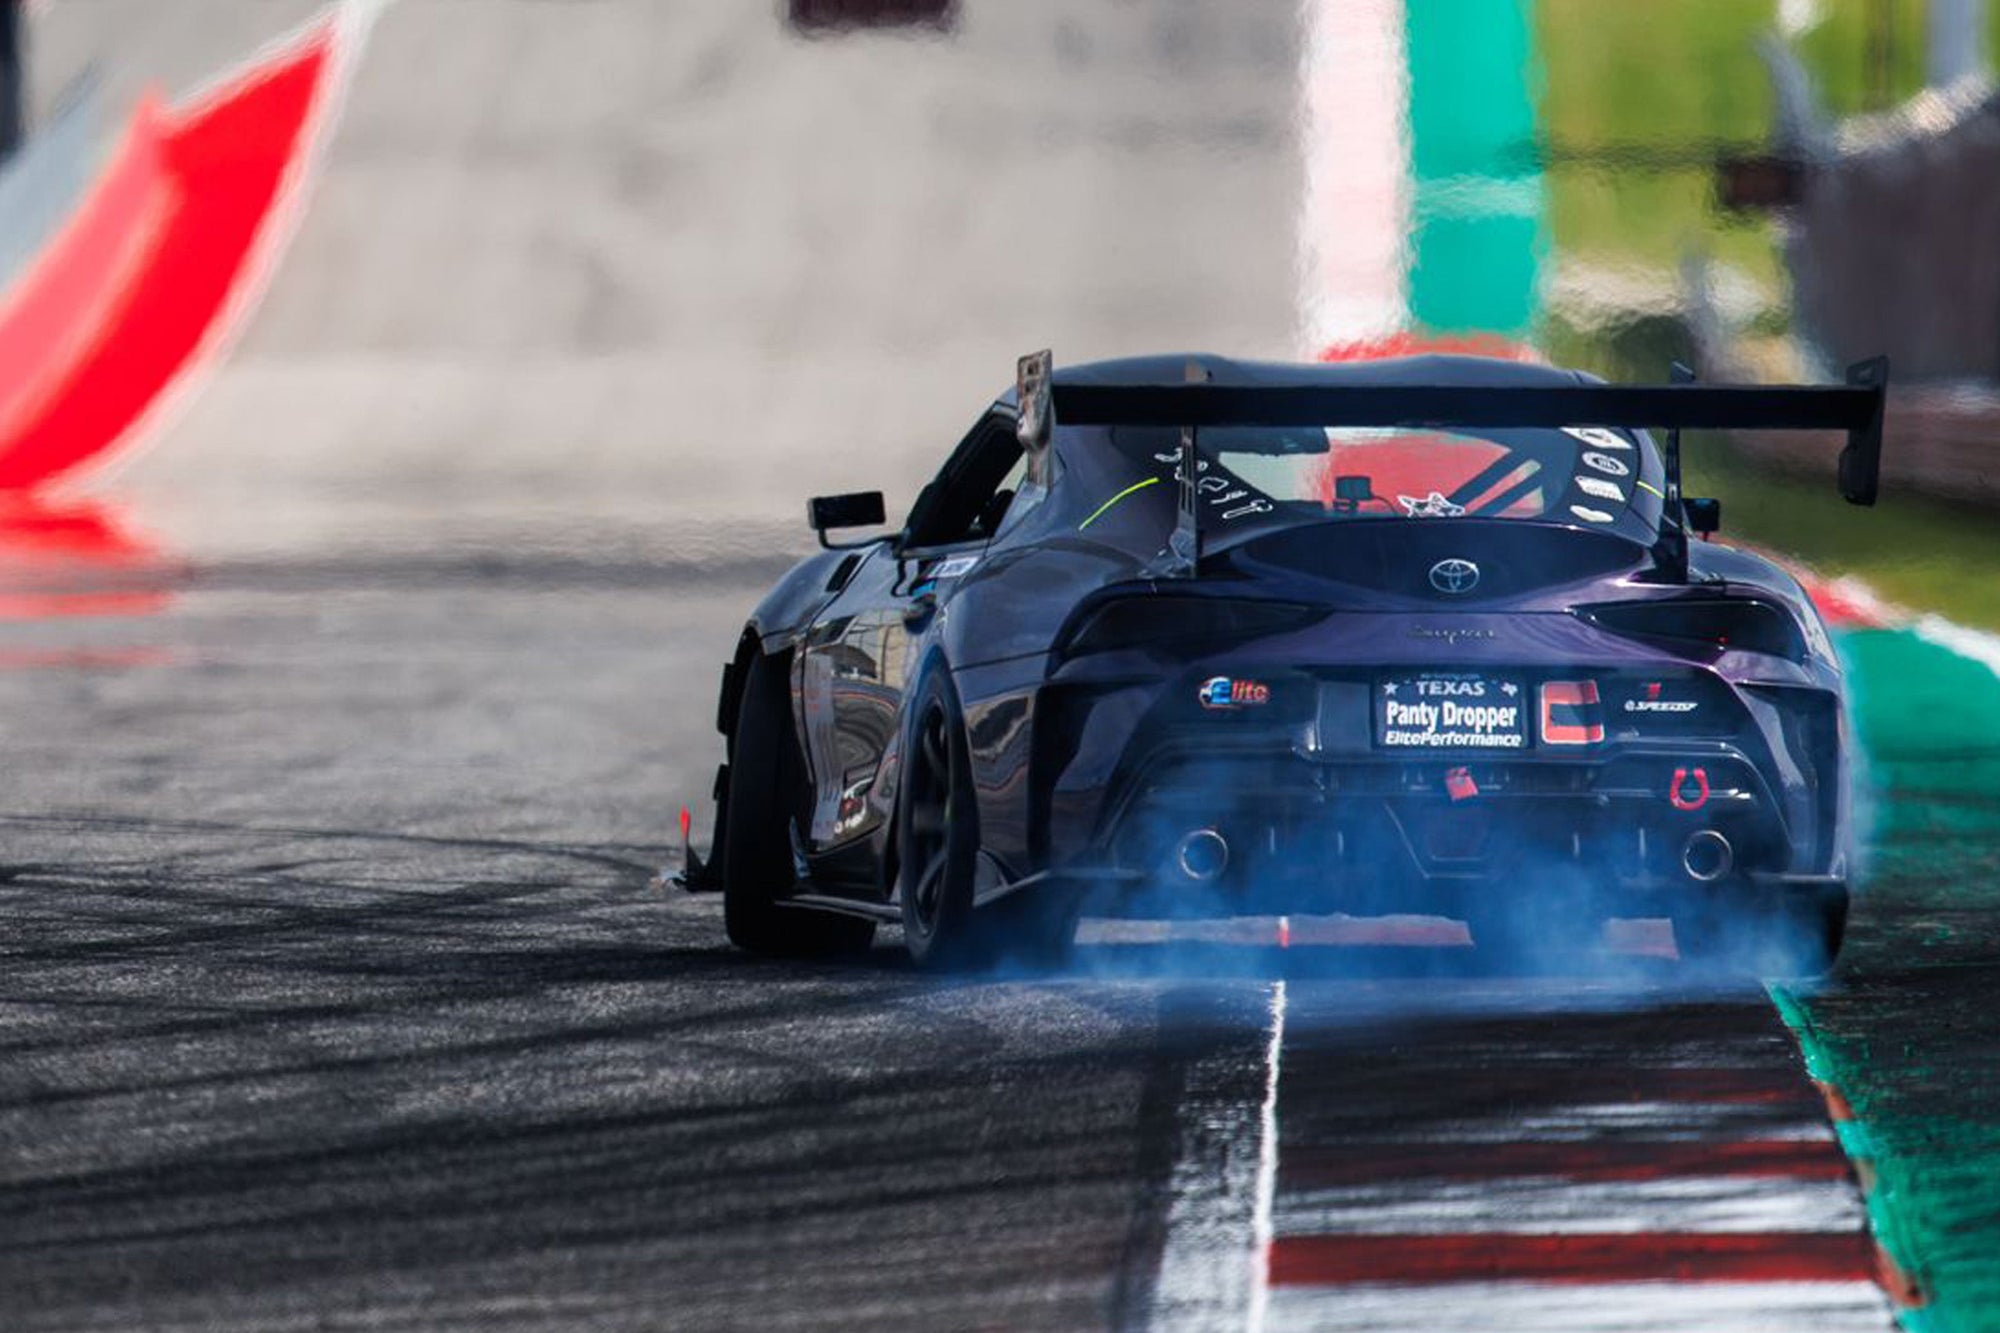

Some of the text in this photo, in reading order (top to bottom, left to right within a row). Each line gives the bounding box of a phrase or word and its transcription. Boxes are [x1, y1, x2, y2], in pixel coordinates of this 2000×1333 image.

[1204, 678, 1269, 704] Elite
[1416, 681, 1485, 696] TEXAS
[1386, 700, 1517, 733] Panty Dropper
[1385, 731, 1522, 747] ElitePerformance
